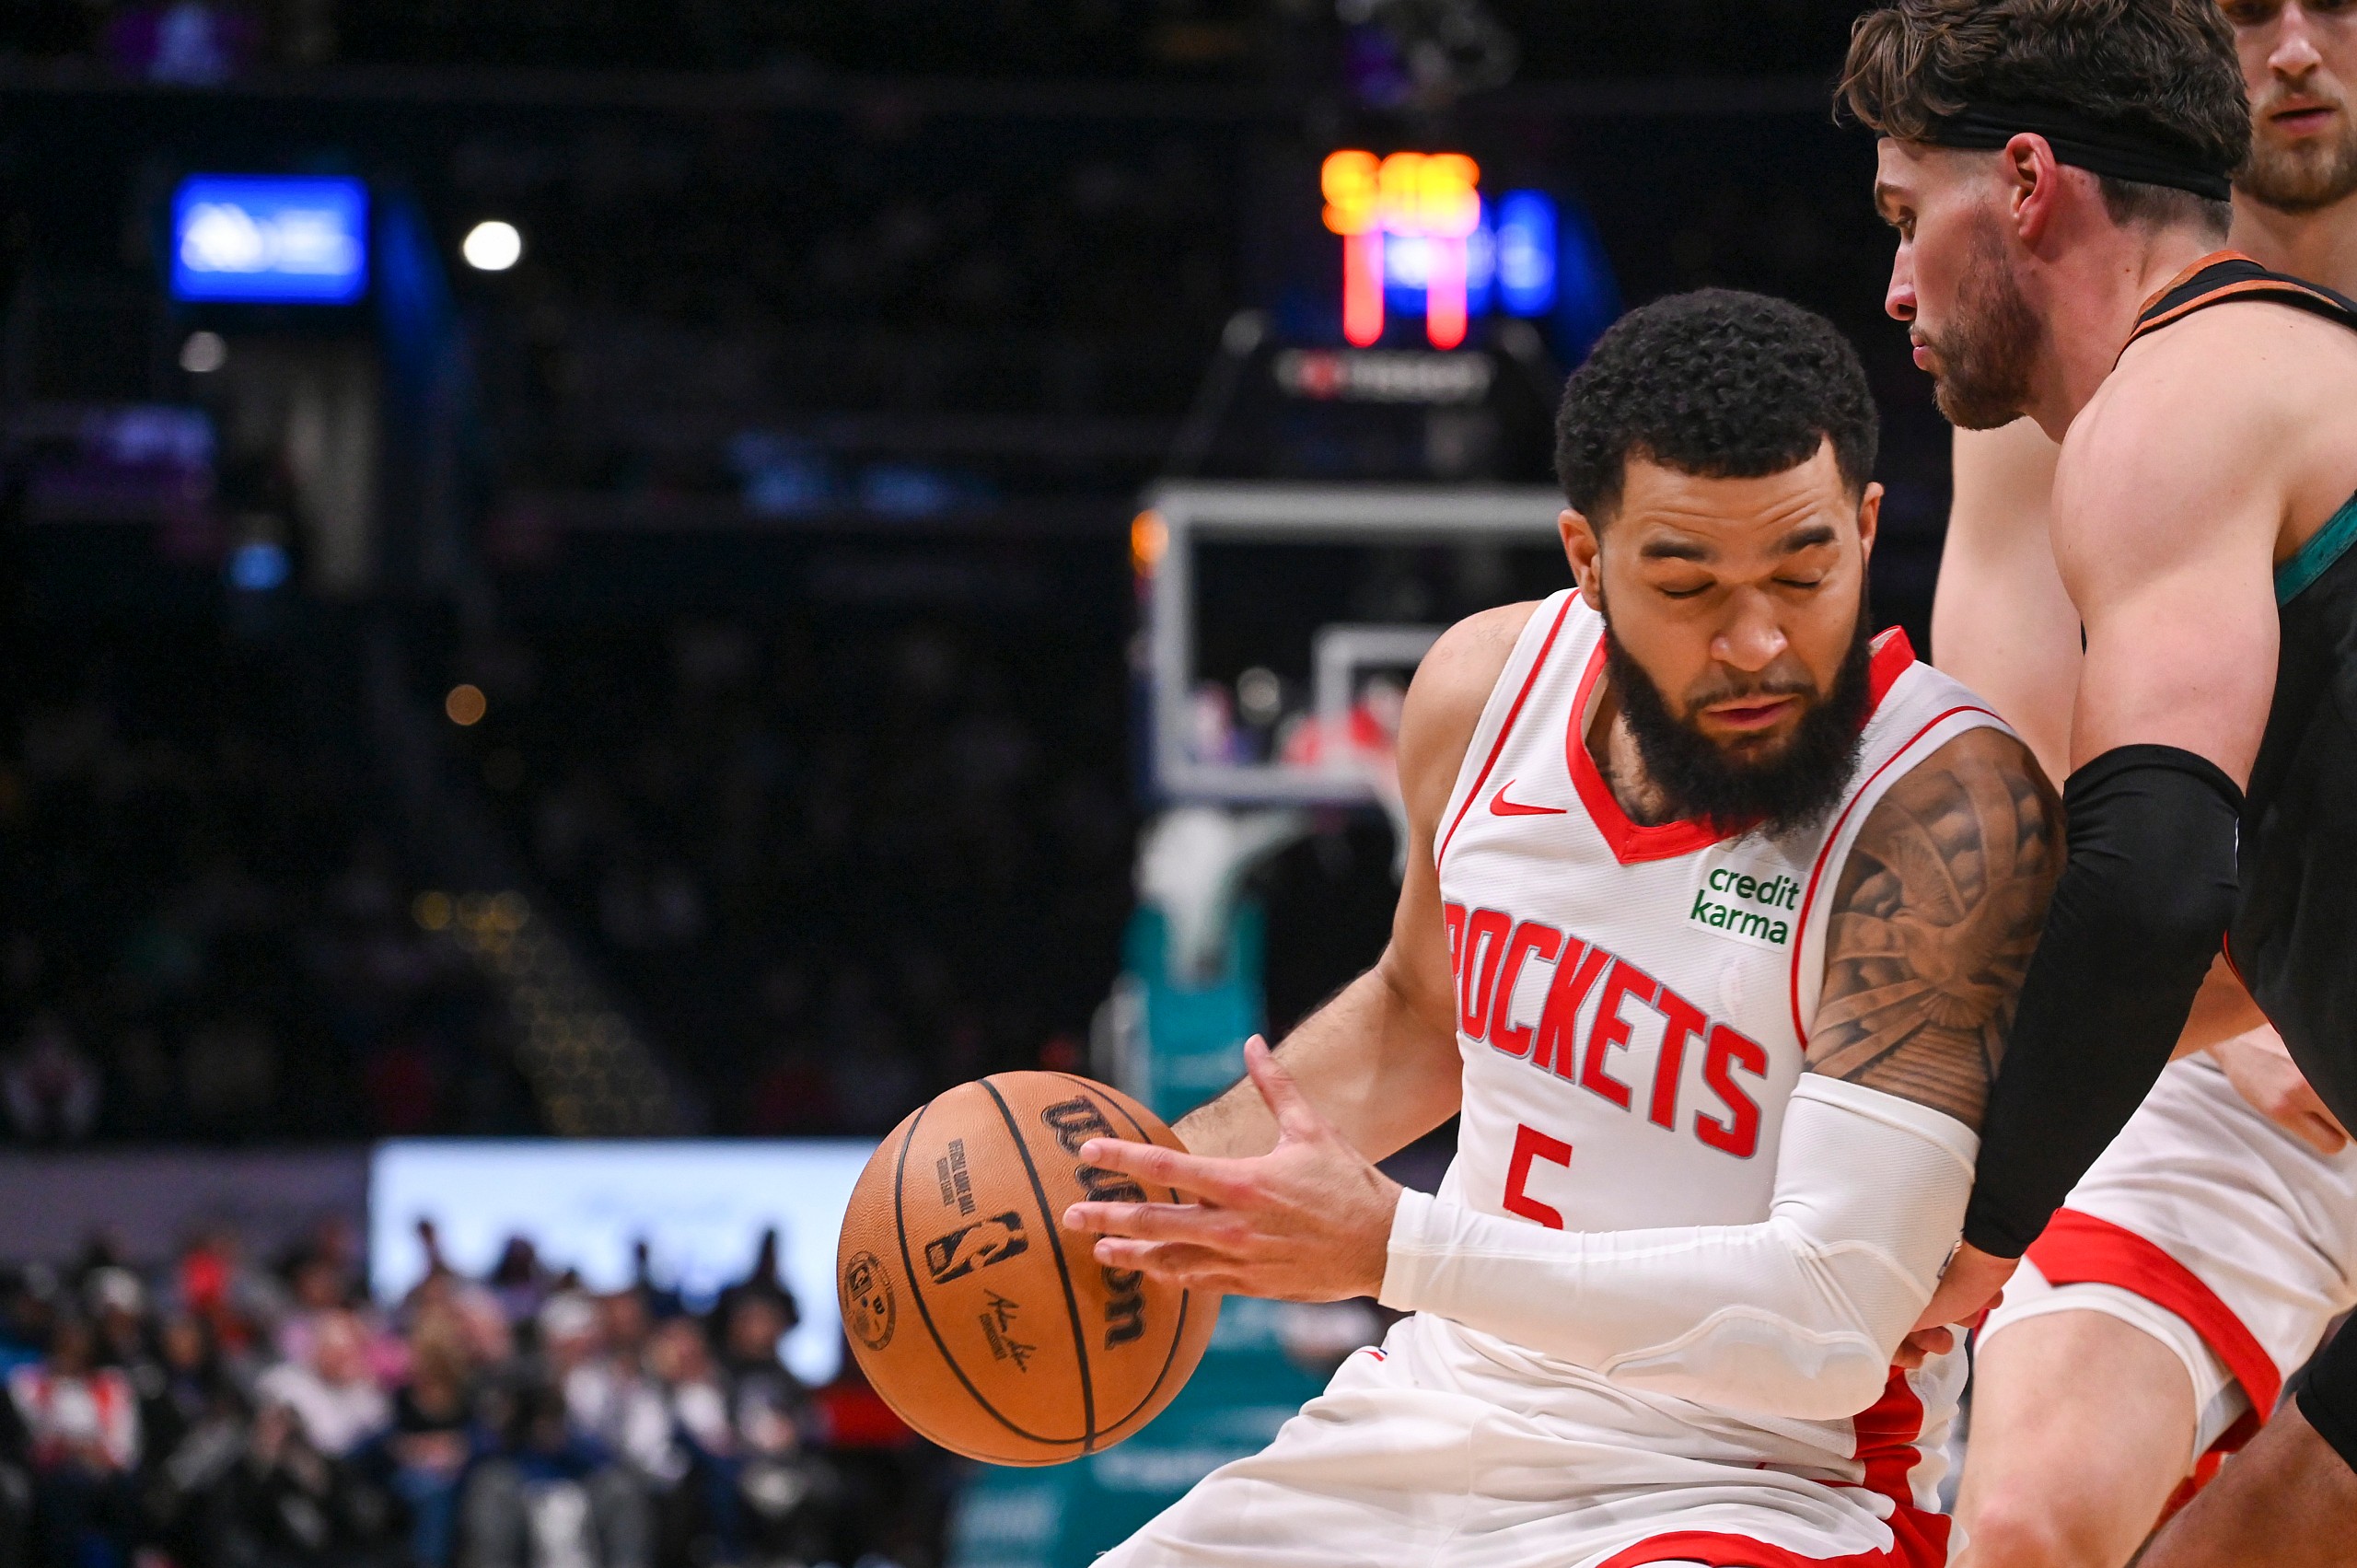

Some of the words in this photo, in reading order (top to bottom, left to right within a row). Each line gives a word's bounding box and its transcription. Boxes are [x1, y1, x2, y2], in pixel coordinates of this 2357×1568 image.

[1690, 889, 1789, 945] karma
[1709, 868, 1800, 911] credit
[1503, 1122, 1573, 1231] 5
[1040, 1095, 1146, 1352] Wilon
